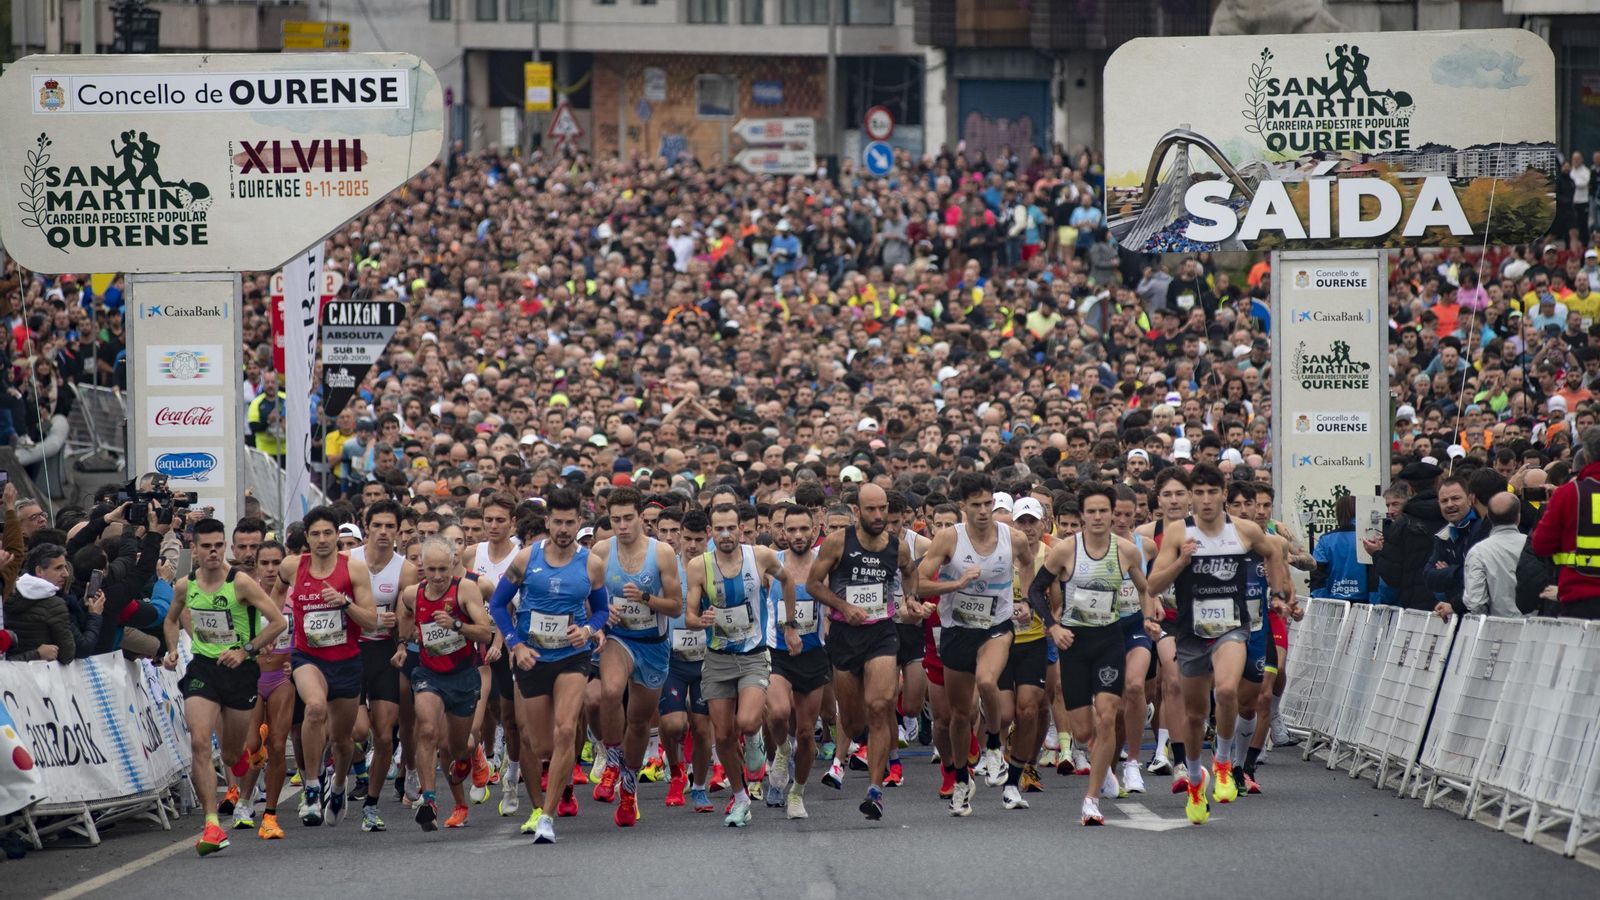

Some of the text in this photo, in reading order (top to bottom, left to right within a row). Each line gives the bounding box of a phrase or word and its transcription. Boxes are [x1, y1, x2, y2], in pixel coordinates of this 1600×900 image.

[77, 76, 399, 106] Concello de OURENSE
[1266, 76, 1329, 97] SAN
[1267, 98, 1391, 119] MARTIN
[1266, 117, 1410, 131] CARREIRA PEDESTRE POPULAR
[1266, 129, 1411, 152] OURENSE
[239, 138, 362, 175] XLVIII
[45, 165, 116, 188] SAN
[238, 178, 369, 199] OURENSE 9-11-2025
[46, 188, 185, 212] MARTIN
[1184, 161, 1474, 242] SAÍDA
[46, 210, 207, 225] CARREIRA PEDESTRE POPULAR
[46, 223, 209, 248] OURENSE
[1315, 269, 1360, 278] Concello de
[1315, 278, 1368, 288] OURENSE
[164, 305, 221, 318] CaixaBank
[328, 302, 395, 325] CAIXÓN 1
[1313, 310, 1365, 322] CaixaBank
[326, 331, 384, 340] ABSOLUTA
[333, 346, 366, 354] SUB 18
[1302, 354, 1333, 364] SAN
[1302, 365, 1360, 374] MARTIN
[1302, 380, 1370, 390] OURENSE
[155, 406, 215, 426] Coca-Cola
[1316, 414, 1349, 422] Concello
[1316, 423, 1368, 432] OURENSE
[158, 457, 213, 471] aquaBona
[1313, 455, 1366, 467] CaixaBank
[1302, 499, 1332, 508] SAN
[1192, 557, 1239, 575] delikia
[860, 568, 887, 577] BARCO
[298, 593, 320, 602] ALEX
[852, 592, 878, 604] 2885
[621, 604, 641, 614] 736
[960, 600, 985, 612] 2878
[1090, 599, 1097, 609] 2
[725, 614, 733, 624] 5
[1200, 608, 1227, 619] 9751
[200, 617, 218, 628] 162
[309, 619, 335, 630] 2876
[540, 621, 558, 632] 157
[425, 628, 451, 641] 2882
[681, 637, 699, 647] 721
